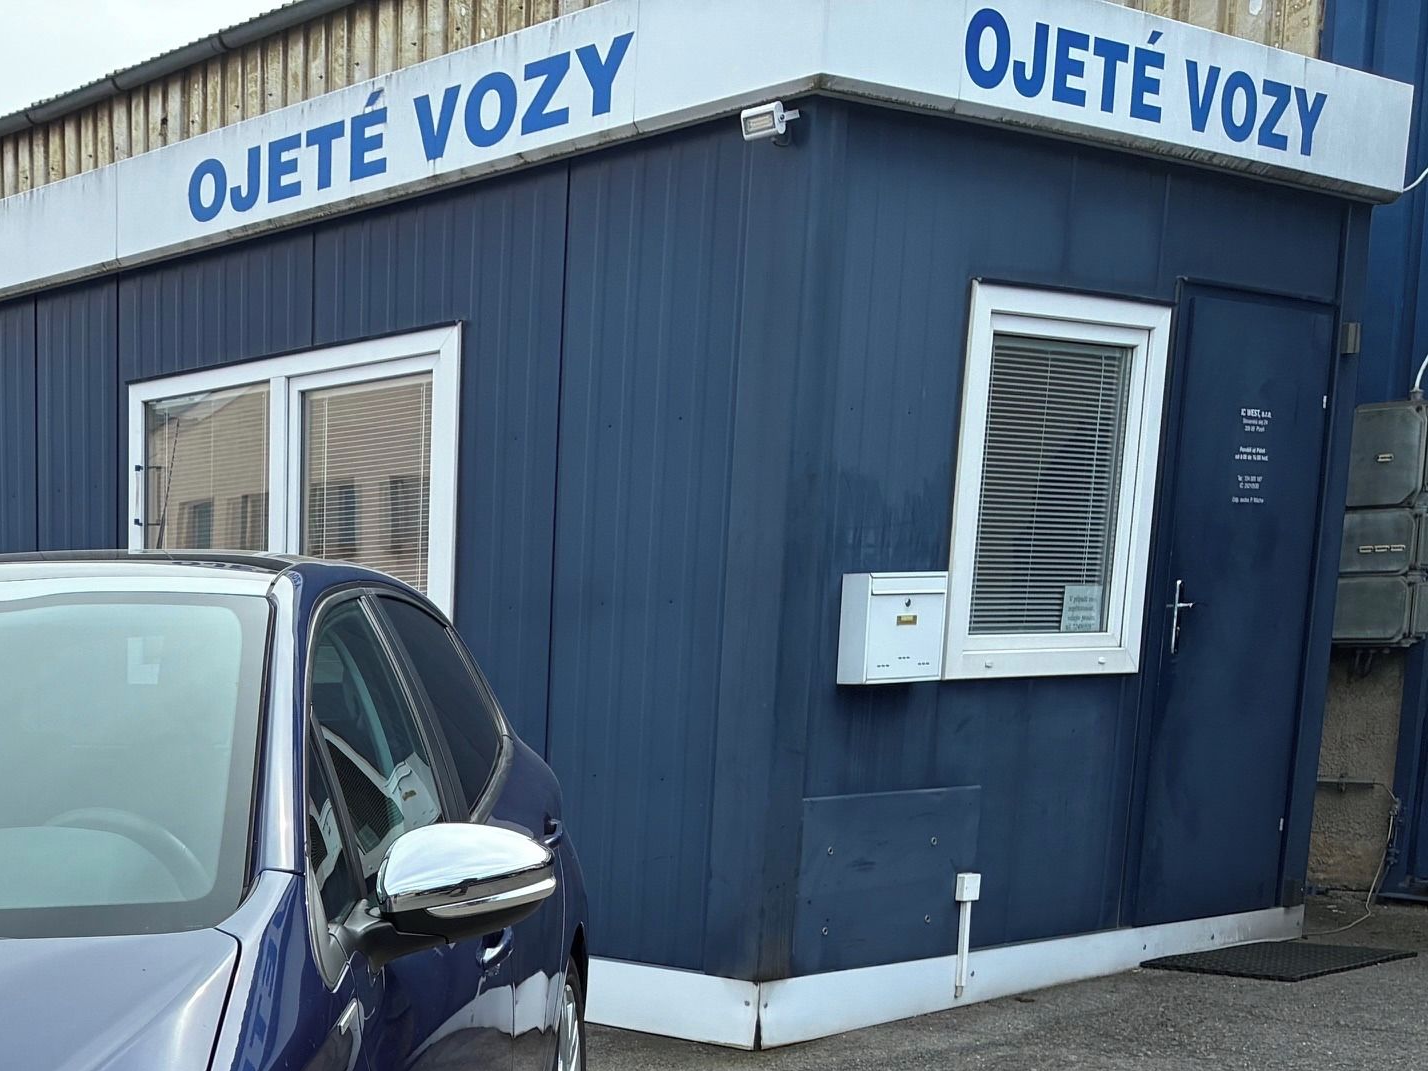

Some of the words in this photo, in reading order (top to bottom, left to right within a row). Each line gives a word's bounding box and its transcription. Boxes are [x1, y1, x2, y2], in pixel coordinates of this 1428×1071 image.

[188, 89, 388, 222] OJETÉ
[413, 31, 635, 162] VOZY
[965, 8, 1165, 123] OJETÉ
[1186, 59, 1328, 156] VOZY
